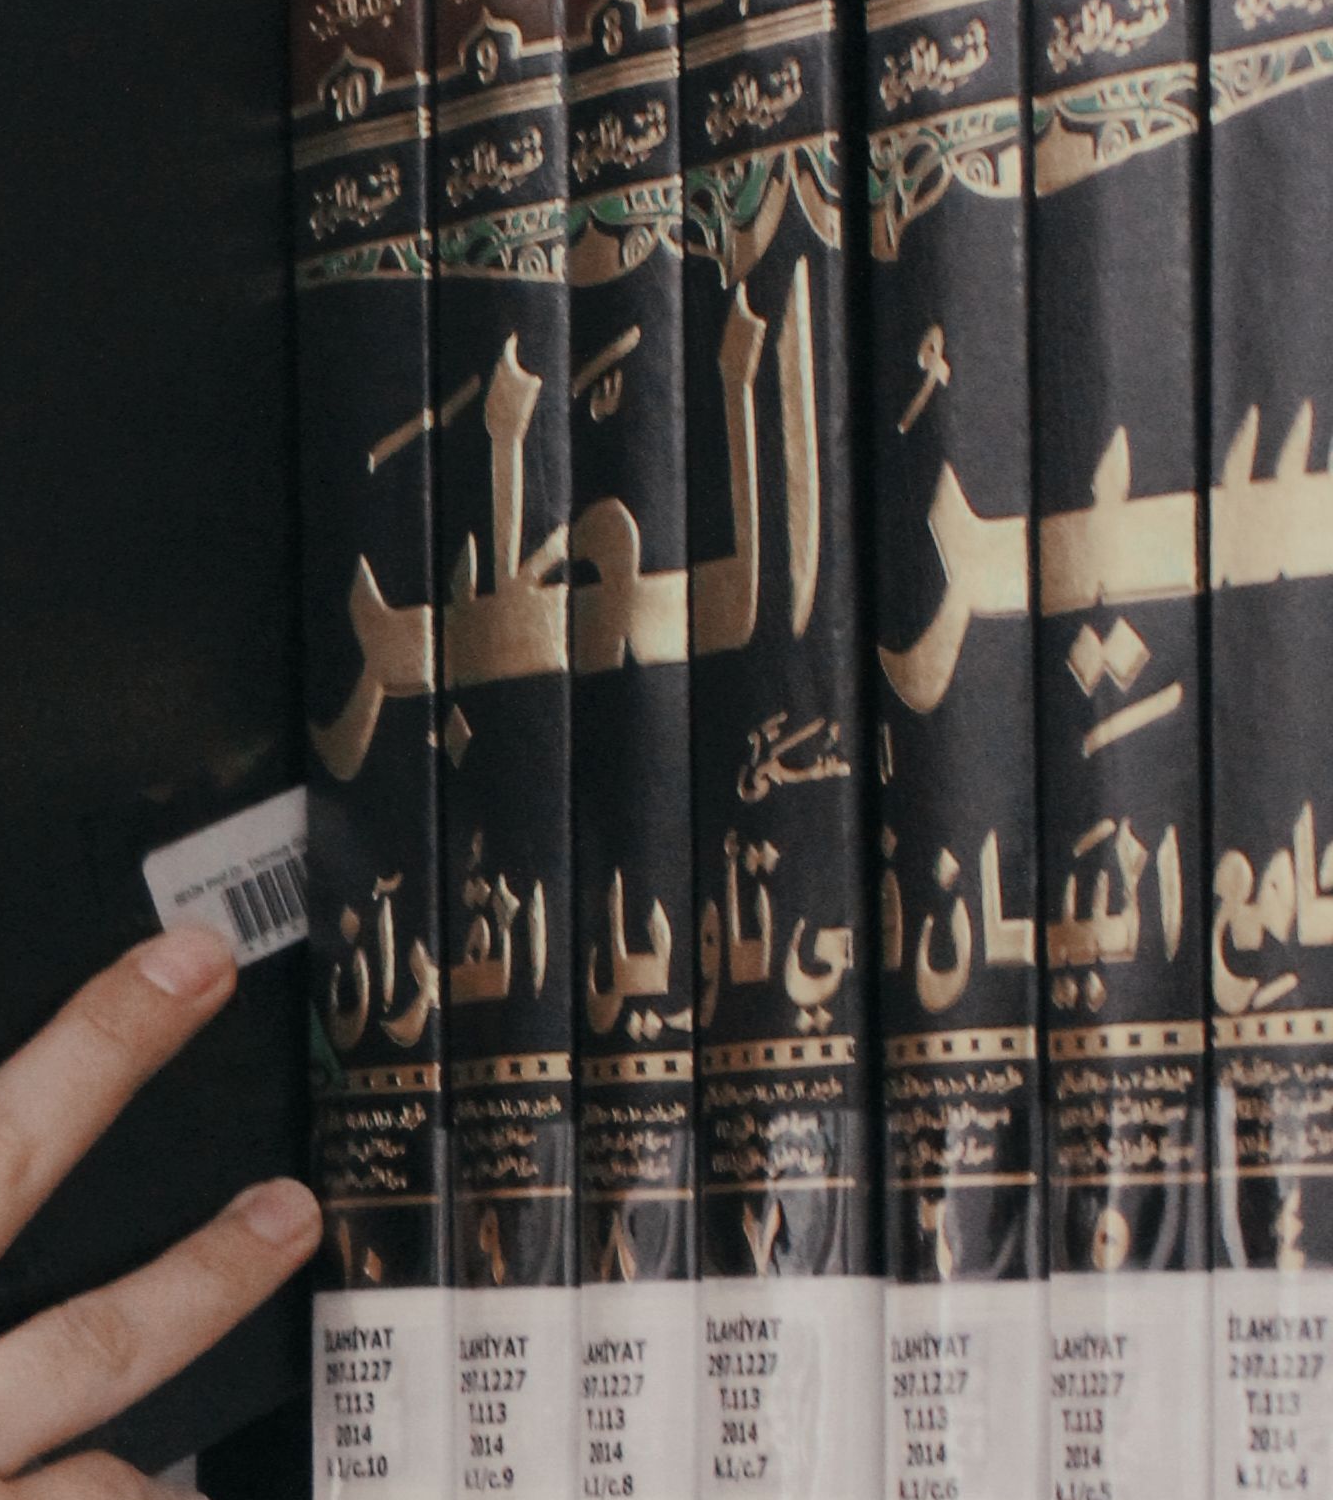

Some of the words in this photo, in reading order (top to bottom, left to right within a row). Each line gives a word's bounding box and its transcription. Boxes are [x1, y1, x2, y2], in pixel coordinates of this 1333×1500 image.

[601, 6, 623, 56] 8
[476, 36, 500, 84] 9
[479, 1206, 506, 1285] ٩
[599, 1209, 635, 1284] ٨
[742, 1199, 781, 1277] ٧
[706, 1313, 782, 1344] İLAHİYAT
[720, 1387, 760, 1411] T.113
[1246, 1389, 1301, 1417] T.113
[468, 1401, 507, 1426] T.113
[903, 1405, 949, 1431] T.113
[1062, 1408, 1104, 1435] T.113
[470, 1433, 504, 1457] 2014
[722, 1420, 759, 1445] 2014
[906, 1442, 947, 1467] 2014
[1065, 1444, 1102, 1470] 2014
